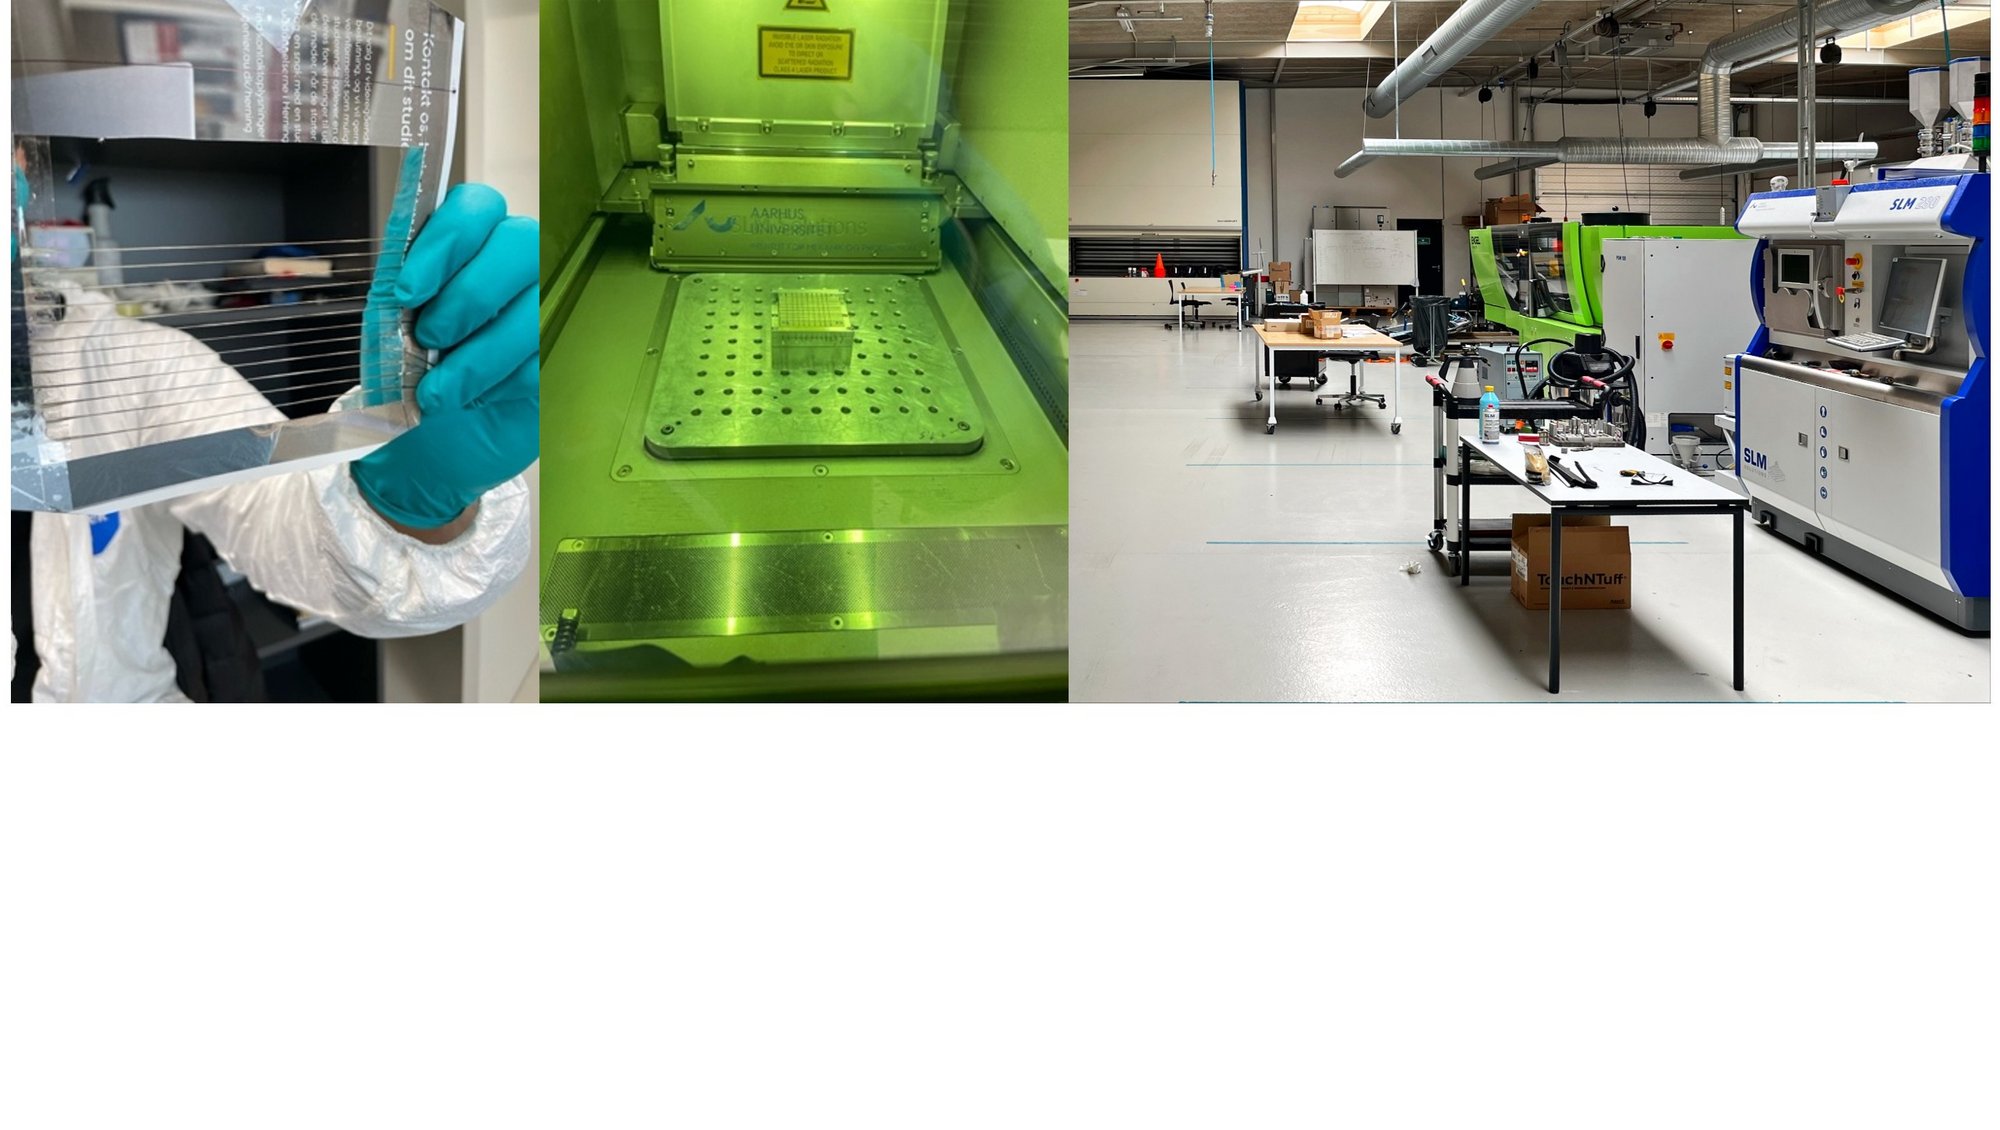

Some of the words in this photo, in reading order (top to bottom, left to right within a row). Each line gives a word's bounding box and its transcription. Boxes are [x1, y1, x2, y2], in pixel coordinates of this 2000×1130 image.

[294, 34, 301, 49] en
[404, 29, 415, 60] om
[364, 39, 373, 61] valg
[366, 63, 372, 74] af
[420, 33, 435, 107] Kontakt
[352, 79, 360, 92] og
[403, 66, 415, 91] dit
[311, 91, 318, 105] de
[294, 107, 301, 121] en
[281, 101, 290, 142] Herning
[333, 121, 338, 134] en
[417, 112, 429, 137] os,
[1890, 198, 1917, 210] SLM
[751, 207, 804, 220] AARHUS
[751, 222, 832, 236] UNIVERSITET
[1744, 448, 1766, 470] SLM
